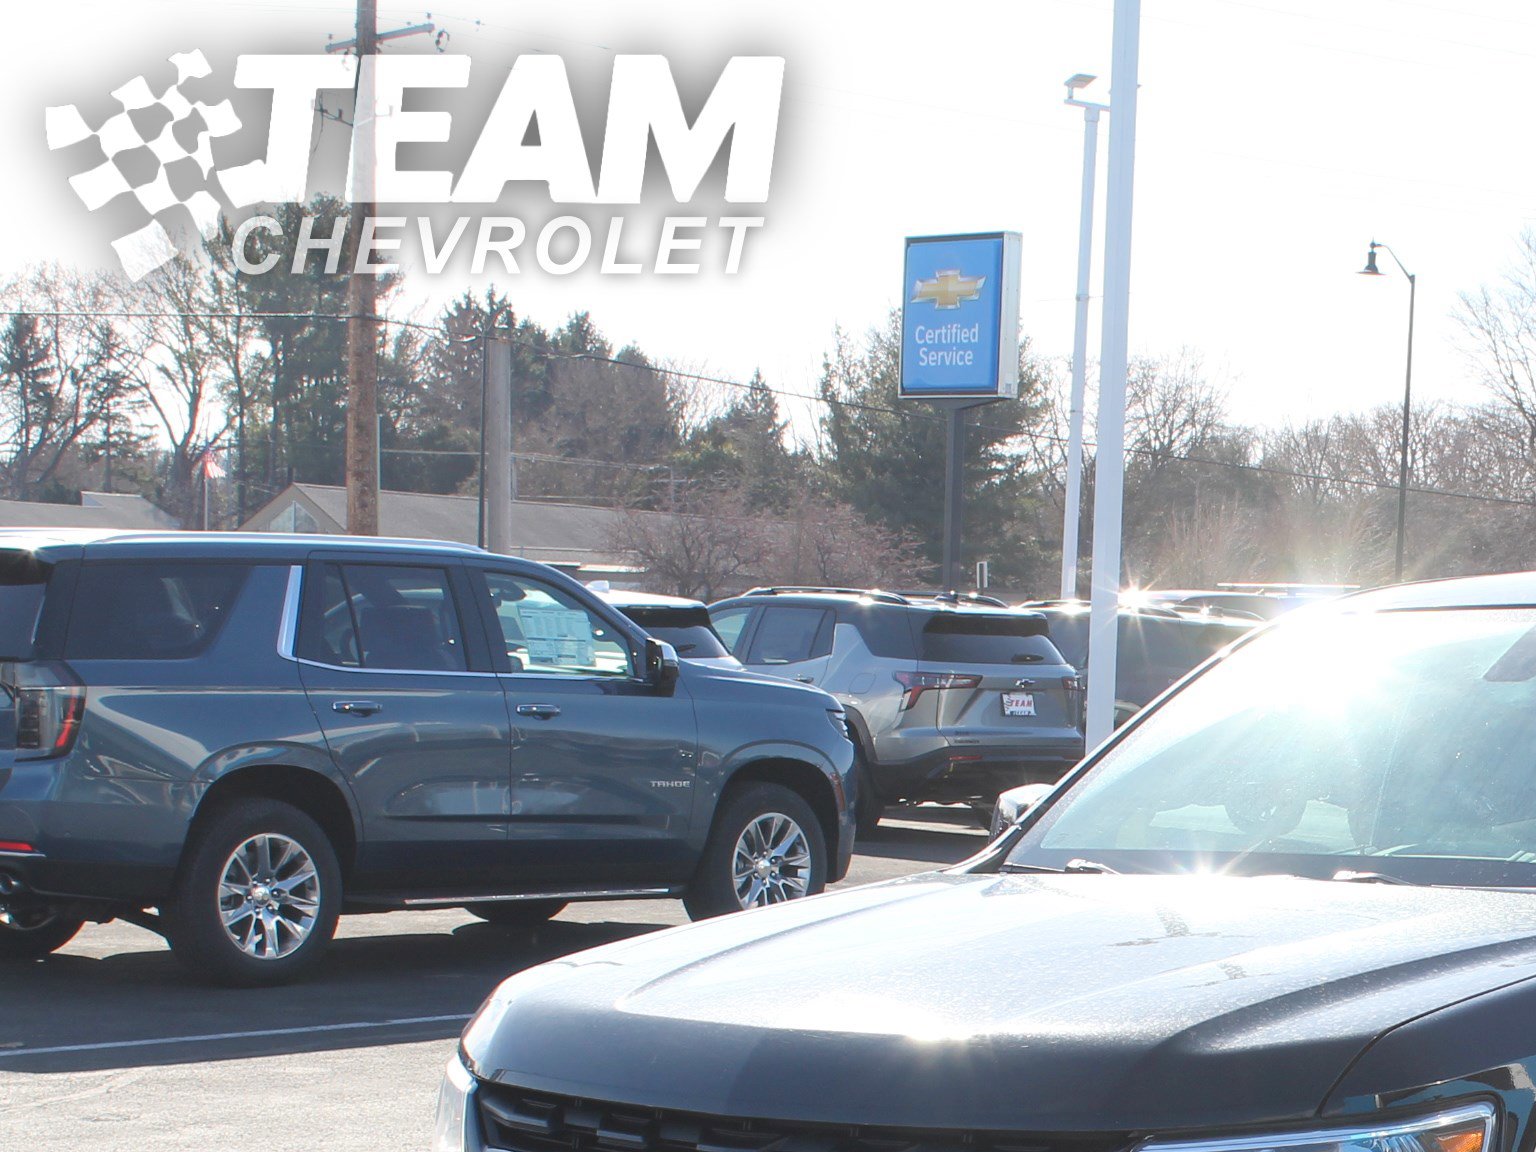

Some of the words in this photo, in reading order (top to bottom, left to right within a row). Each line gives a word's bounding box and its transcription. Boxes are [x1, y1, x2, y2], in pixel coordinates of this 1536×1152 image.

[915, 323, 979, 344] Certified
[919, 347, 974, 366] Service
[1010, 699, 1033, 707] TEAM
